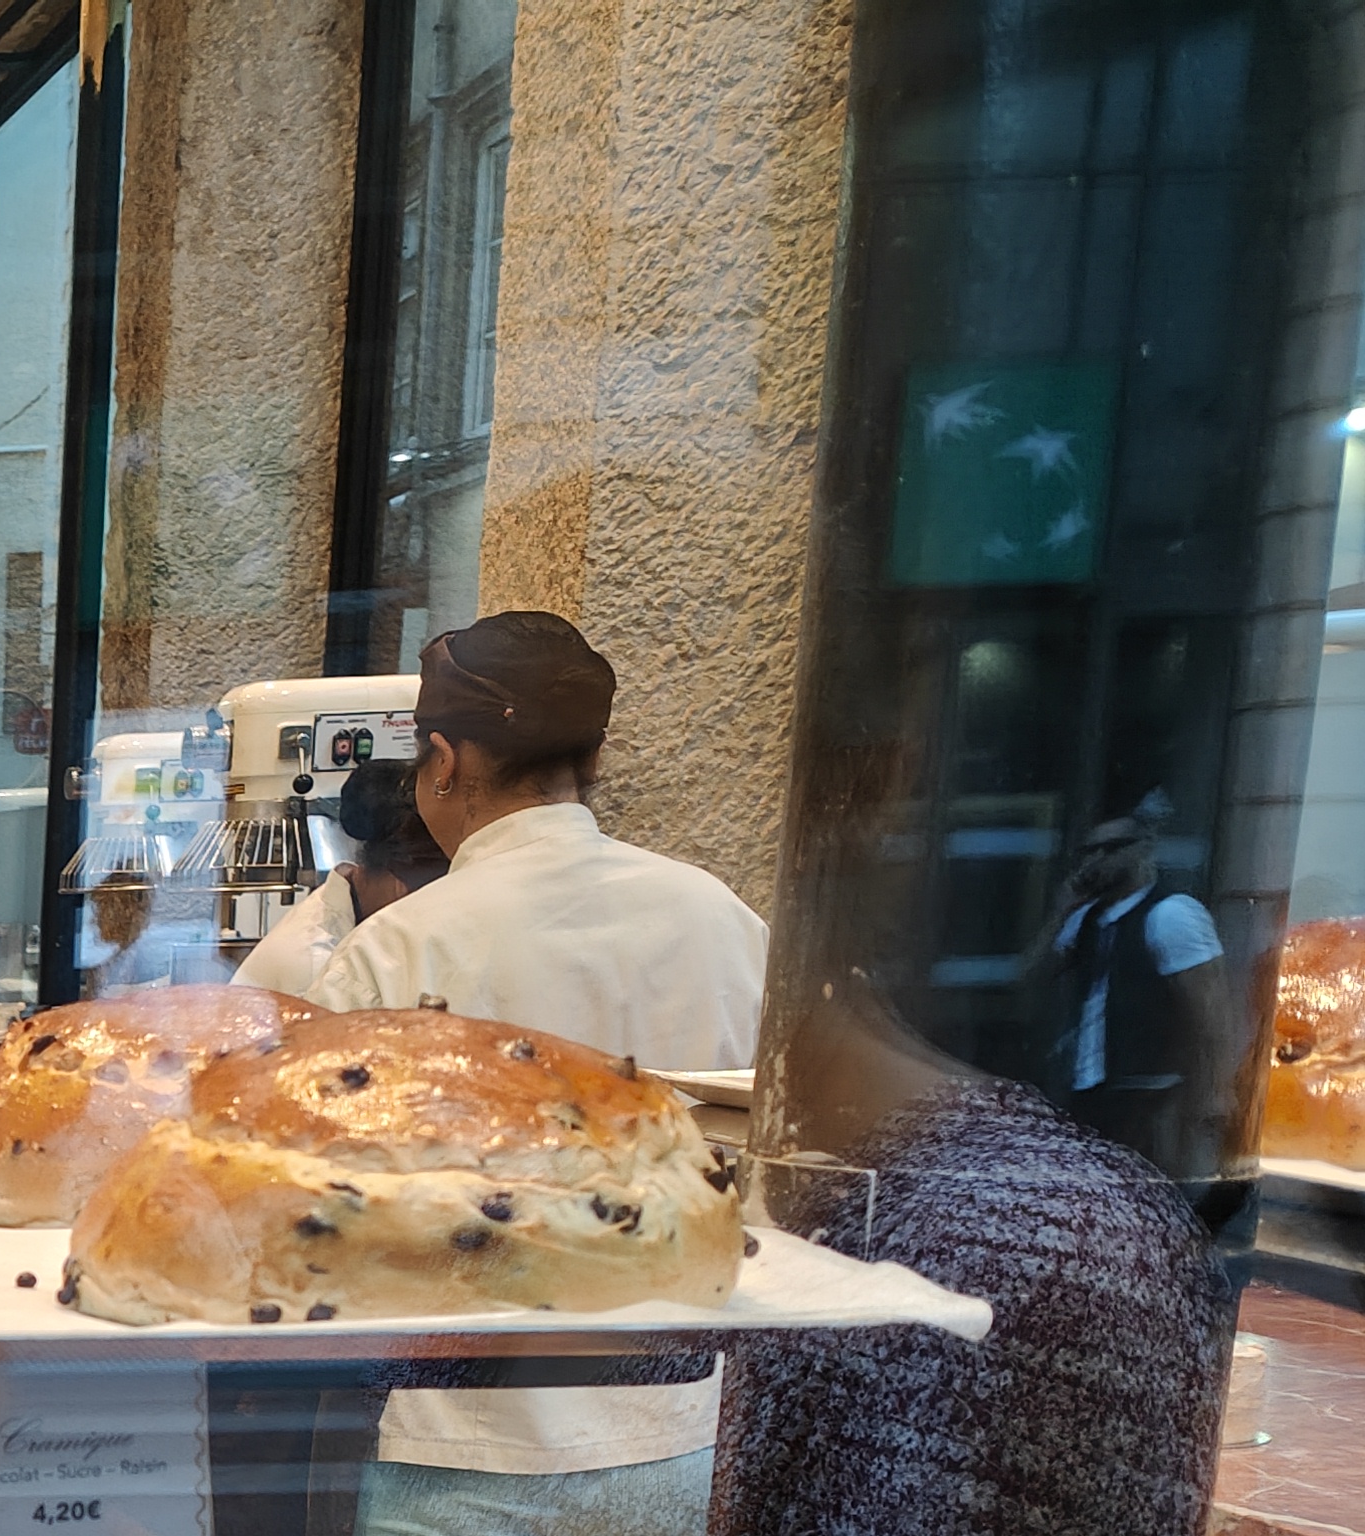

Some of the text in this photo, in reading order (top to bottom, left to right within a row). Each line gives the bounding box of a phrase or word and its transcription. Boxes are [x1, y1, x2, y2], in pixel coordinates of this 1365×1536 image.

[57, 1461, 102, 1480] Sucre
[120, 1458, 167, 1475] Raisin
[33, 1500, 102, 1526] 4,20€
